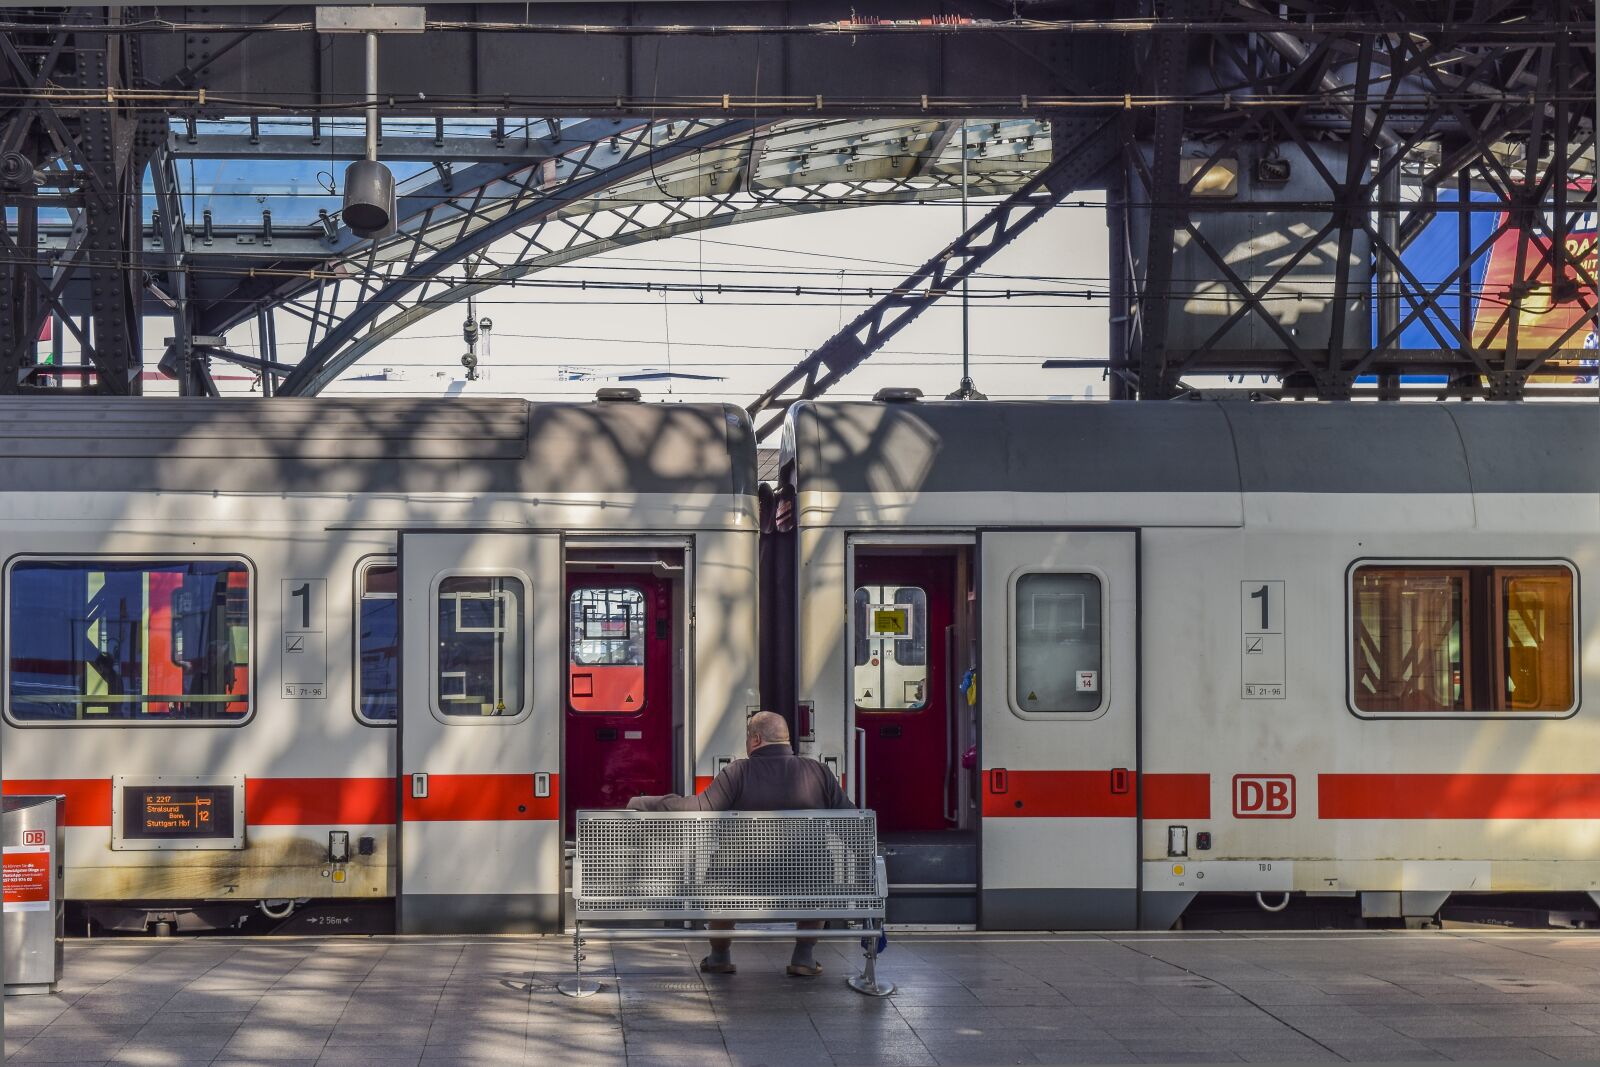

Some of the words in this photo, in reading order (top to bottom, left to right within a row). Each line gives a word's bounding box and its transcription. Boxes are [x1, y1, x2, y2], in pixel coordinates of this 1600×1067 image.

[291, 583, 310, 628] 1
[1250, 585, 1269, 630] 1
[1083, 680, 1092, 688] 14
[1240, 781, 1289, 811] DB
[146, 805, 180, 813] Stralsund
[198, 810, 209, 822] 12
[146, 820, 177, 828] Stuttgart
[25, 832, 43, 844] DB
